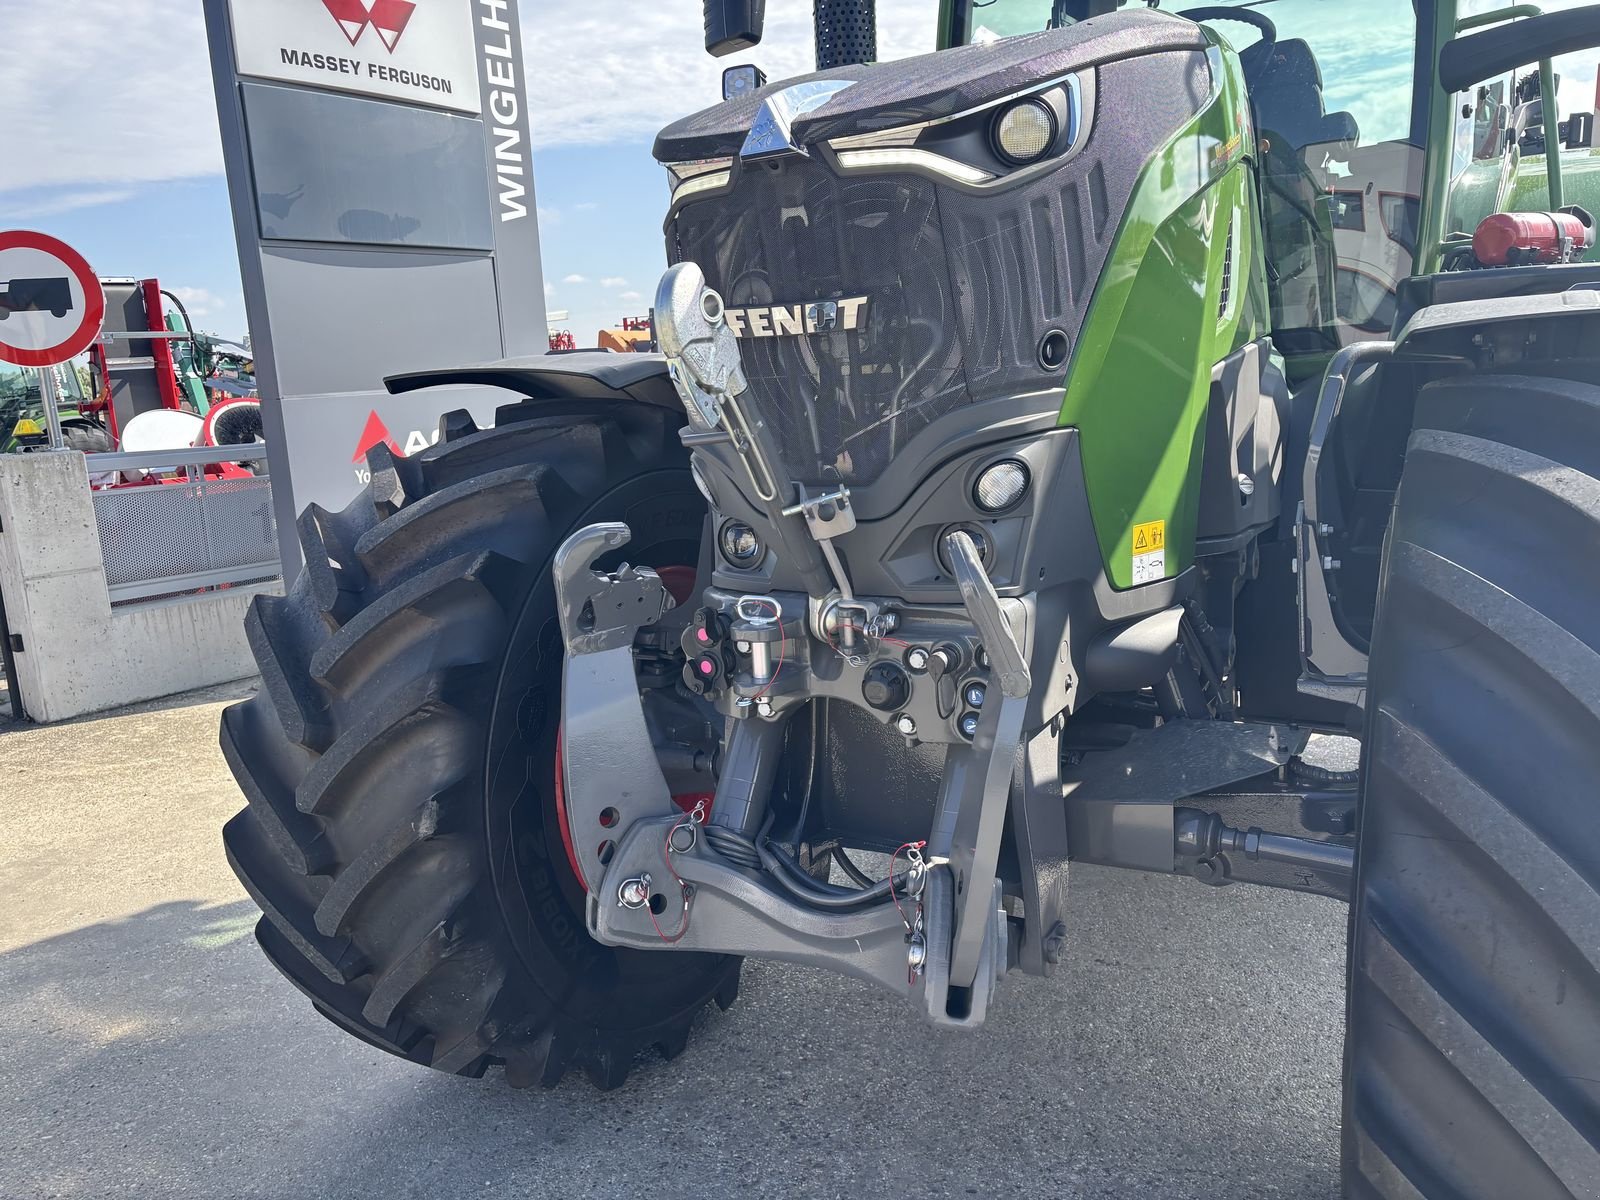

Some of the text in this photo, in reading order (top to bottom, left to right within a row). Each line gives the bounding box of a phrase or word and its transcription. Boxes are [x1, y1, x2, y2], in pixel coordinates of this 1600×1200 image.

[280, 48, 452, 94] MASSEY FERGUSON
[480, 0, 527, 222] WINGELH
[724, 296, 868, 338] FENDT
